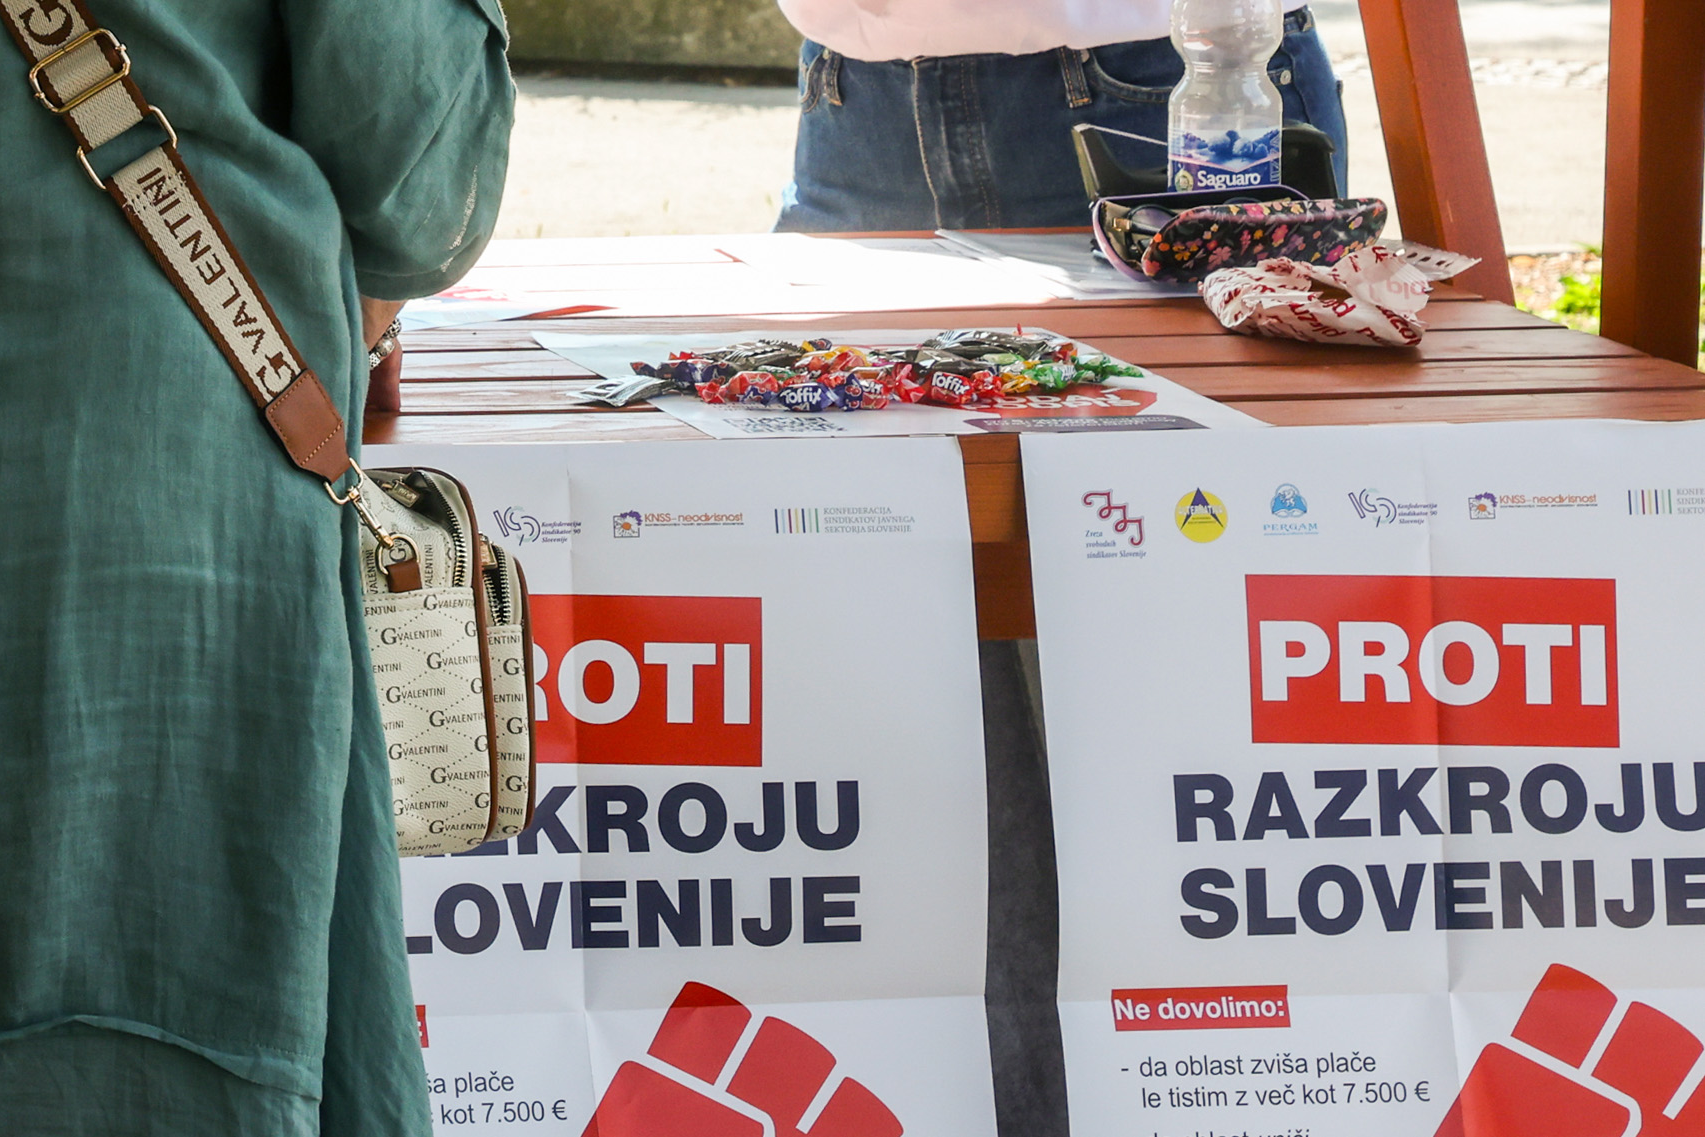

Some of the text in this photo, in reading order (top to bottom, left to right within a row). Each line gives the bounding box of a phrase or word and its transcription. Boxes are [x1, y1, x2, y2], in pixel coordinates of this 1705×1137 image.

[1197, 171, 1261, 189] Saguaro
[781, 384, 823, 407] Toffix
[1263, 523, 1318, 532] PERGAM
[1258, 620, 1608, 706] PROTI
[1173, 761, 1705, 842] RAZKROJU
[451, 780, 861, 857] KROJU
[1180, 857, 1705, 939] SLOVENIJE
[1114, 996, 1285, 1020] Ne dovolimo:
[1139, 1056, 1167, 1077] da
[1175, 1055, 1244, 1077] oblast
[1251, 1053, 1308, 1075] zviša
[1316, 1051, 1376, 1078] plače
[454, 1071, 514, 1098] plače
[1142, 1080, 1431, 1108] le tistim z več kot 7.500 €
[441, 1099, 568, 1125] kot 7.500 €
